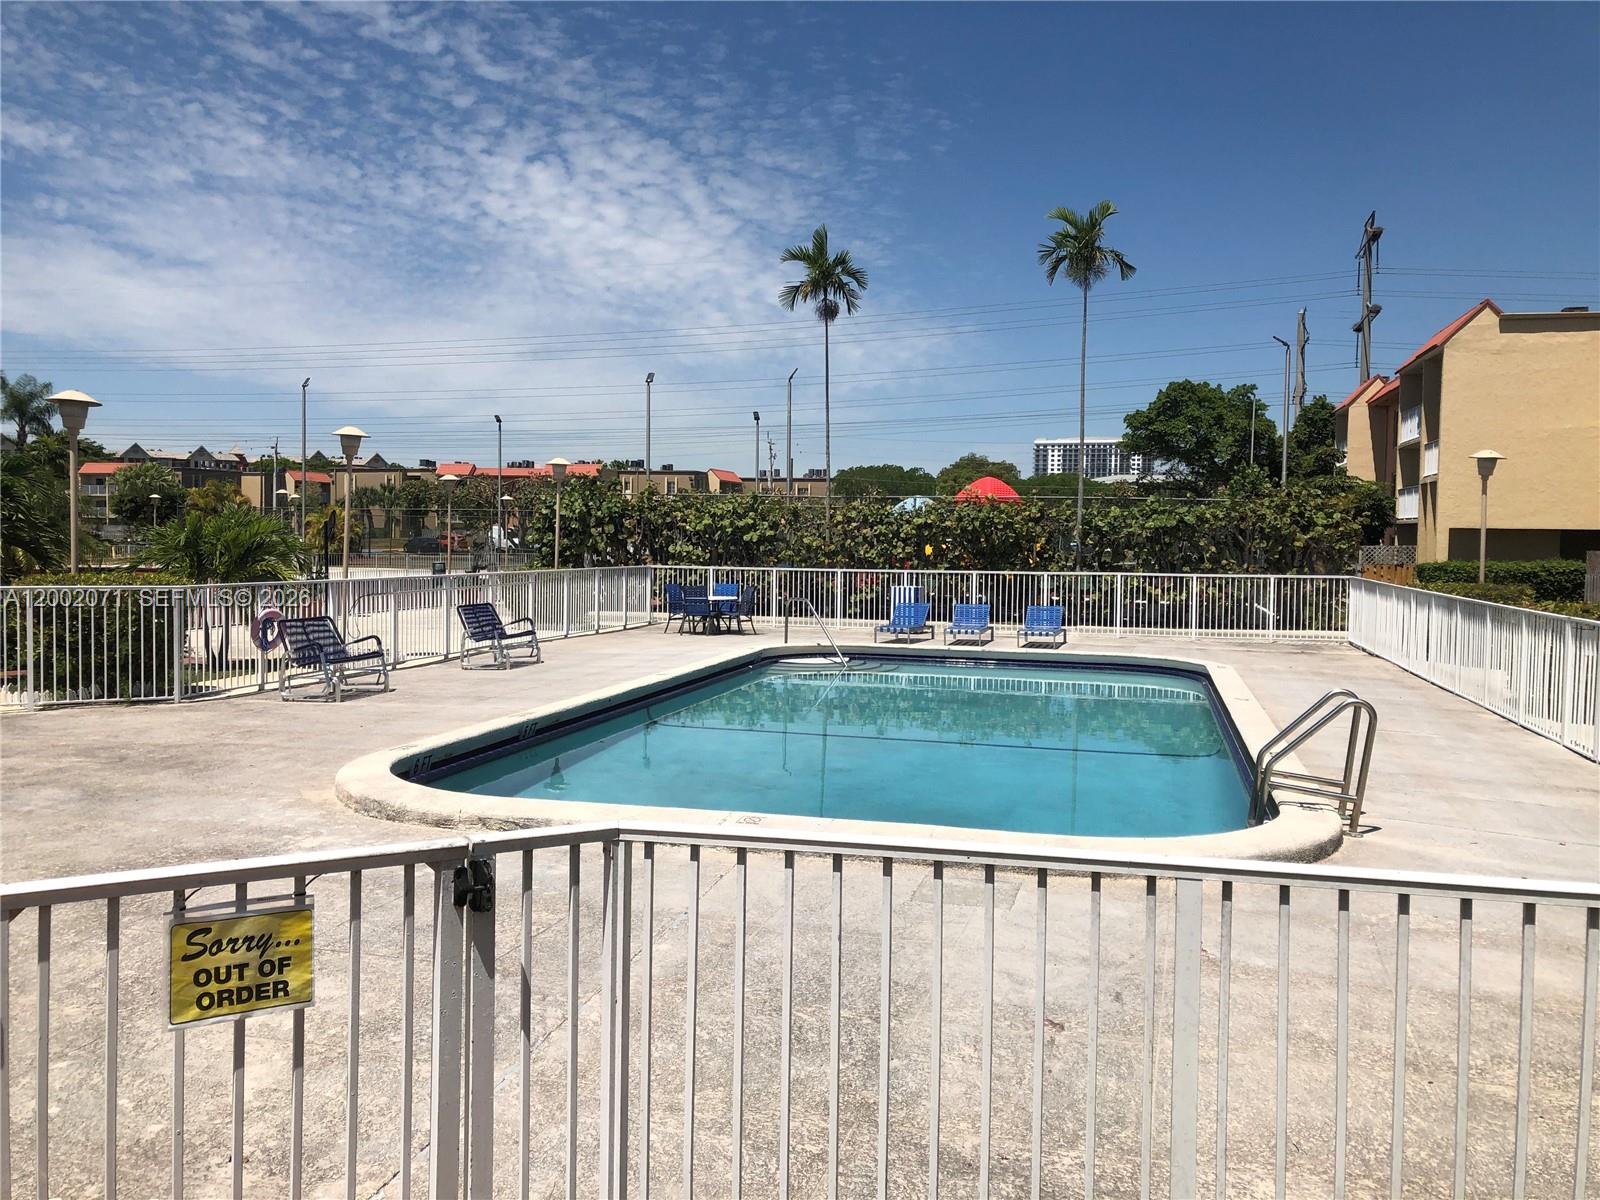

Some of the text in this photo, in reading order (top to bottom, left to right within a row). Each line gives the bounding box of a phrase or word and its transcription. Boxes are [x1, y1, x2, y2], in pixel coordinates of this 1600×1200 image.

[181, 928, 300, 962] Sorry...
[193, 956, 292, 988] OUT OF
[195, 980, 290, 1011] ORDER
